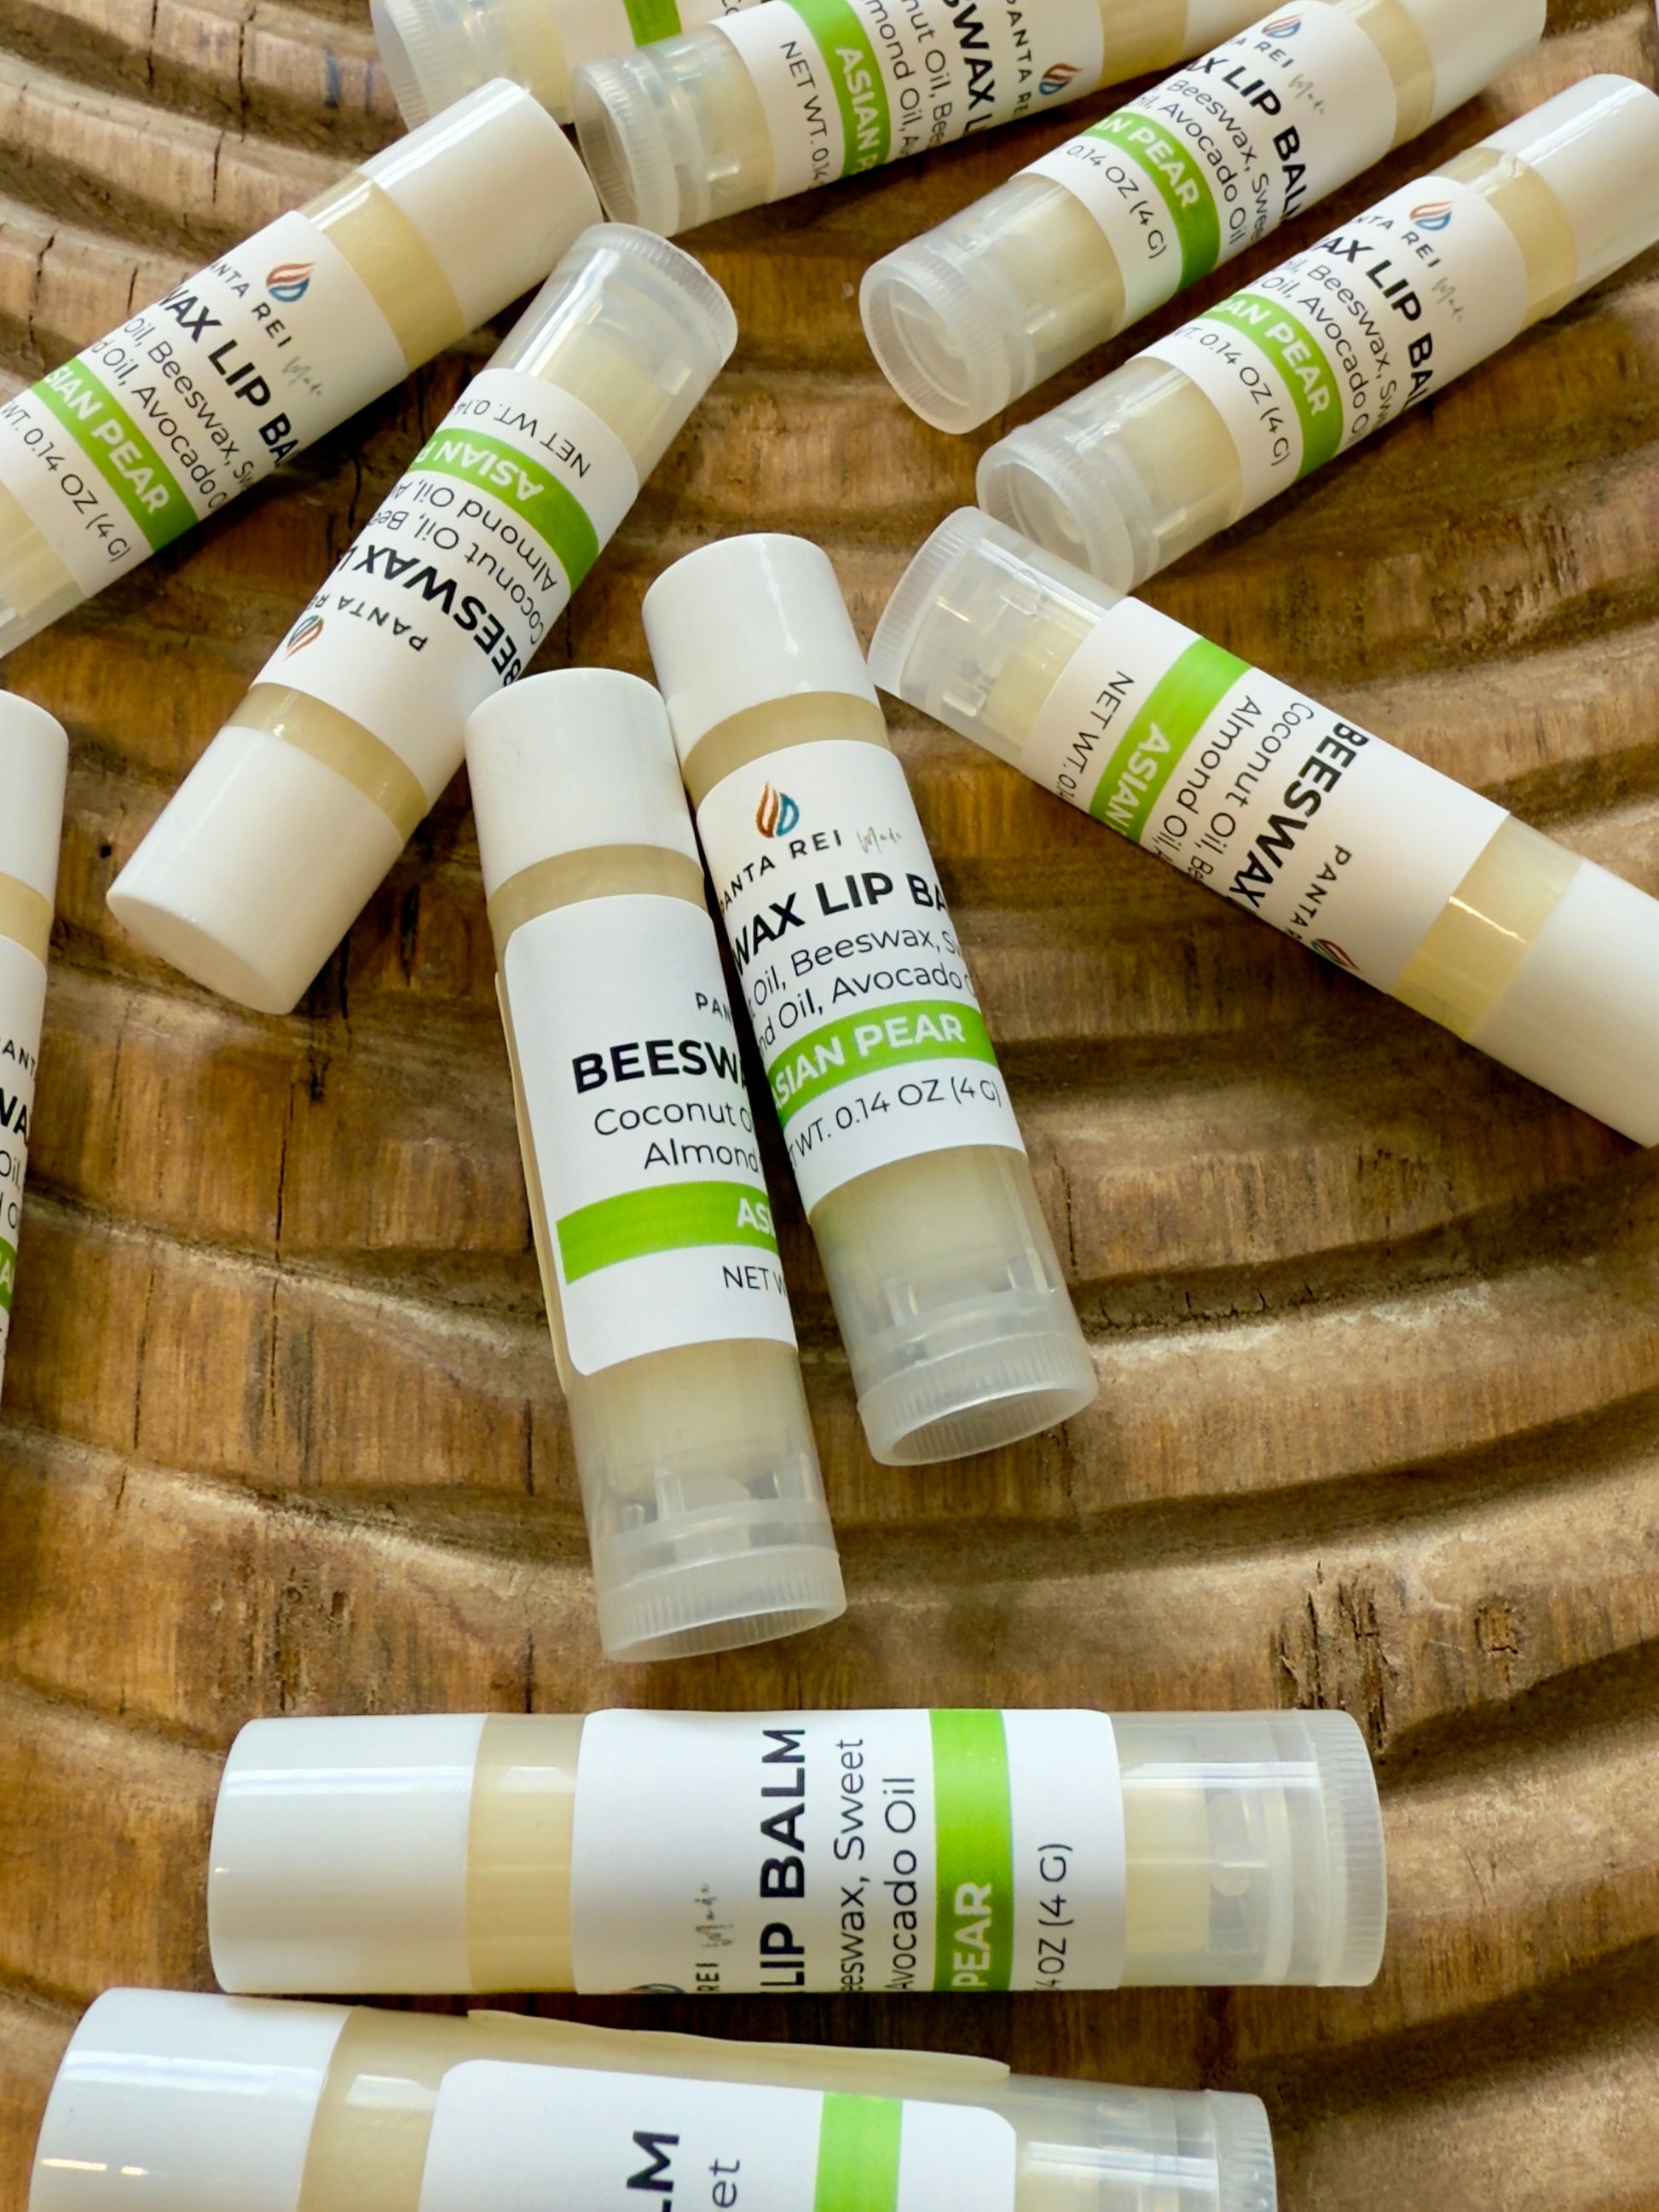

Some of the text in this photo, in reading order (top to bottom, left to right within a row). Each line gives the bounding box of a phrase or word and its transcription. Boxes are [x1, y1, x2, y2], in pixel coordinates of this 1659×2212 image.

[926, 49, 952, 99] Oil,
[1253, 41, 1295, 69] REI
[780, 40, 816, 90] NET
[803, 95, 828, 145] WT.
[834, 45, 879, 151] ASIAN
[899, 88, 923, 132] Oil,
[1222, 66, 1282, 116] LIP
[1157, 103, 1239, 203] Avocado
[1165, 79, 1257, 172] Beeswax,
[1126, 126, 1200, 209] PEAR
[1066, 144, 1167, 260] 0.14 OZ (4 G)
[1401, 231, 1442, 269] REI
[1307, 264, 1391, 379] Beeswax,
[1366, 259, 1422, 322] LIP
[251, 302, 292, 349] REI
[1199, 333, 1243, 366] 0.14
[1297, 296, 1369, 409] Avocado
[124, 317, 156, 348] Oil,
[147, 339, 240, 466] Beeswax,
[208, 339, 271, 407] LIP
[1239, 367, 1273, 405] OZ
[1263, 321, 1330, 416] PEAR
[102, 348, 140, 387] Oil,
[130, 386, 216, 495] Avocado
[493, 402, 539, 438] WT.
[1260, 407, 1284, 434] (4
[90, 418, 171, 515] PEAR
[433, 440, 546, 502] ASIAN
[540, 432, 592, 480] NET
[1270, 437, 1291, 466] G)
[23, 428, 66, 472] 0.14
[61, 473, 100, 516] OZ
[85, 513, 116, 539] (4
[107, 538, 132, 563] G)
[413, 478, 455, 508] Oil,
[413, 512, 460, 551] Oil,
[456, 499, 558, 593] Almond
[337, 594, 429, 653] PANTA
[464, 541, 545, 646] Coconut
[1090, 669, 1136, 731] NET
[1062, 731, 1100, 774] WT.
[1105, 722, 1171, 829] ASIAN
[1176, 695, 1263, 815] Almond
[1224, 702, 1315, 808] Coconut
[789, 829, 843, 860] REI
[1152, 814, 1188, 852] Oil,
[1194, 812, 1236, 855] Oil,
[1228, 721, 1371, 909] BEESWAX
[815, 871, 893, 917] LIP
[1289, 843, 1354, 928] PANTA
[753, 964, 787, 1006] Oil,
[790, 928, 940, 978] Beeswax,
[778, 987, 824, 1030] Oil,
[831, 962, 962, 1005] Avocado
[853, 1012, 967, 1058] PEAR
[594, 1101, 737, 1136] Coconut
[794, 1116, 832, 1158] WT.
[835, 1090, 891, 1130] 0.14
[898, 1077, 945, 1106] OZ
[950, 1076, 976, 1105] (4
[980, 1078, 1003, 1109] G)
[644, 1137, 760, 1174] Almond
[722, 1265, 769, 1291] NET
[834, 1738, 865, 1862] Sweet
[760, 1729, 806, 1987] LIP BALM
[882, 1777, 917, 1991] Avocado Oil
[1037, 1843, 1073, 1883] G)
[952, 1881, 992, 1988] PEAR
[1038, 1893, 1074, 1926] (4
[1038, 1937, 1066, 1975] OZ
